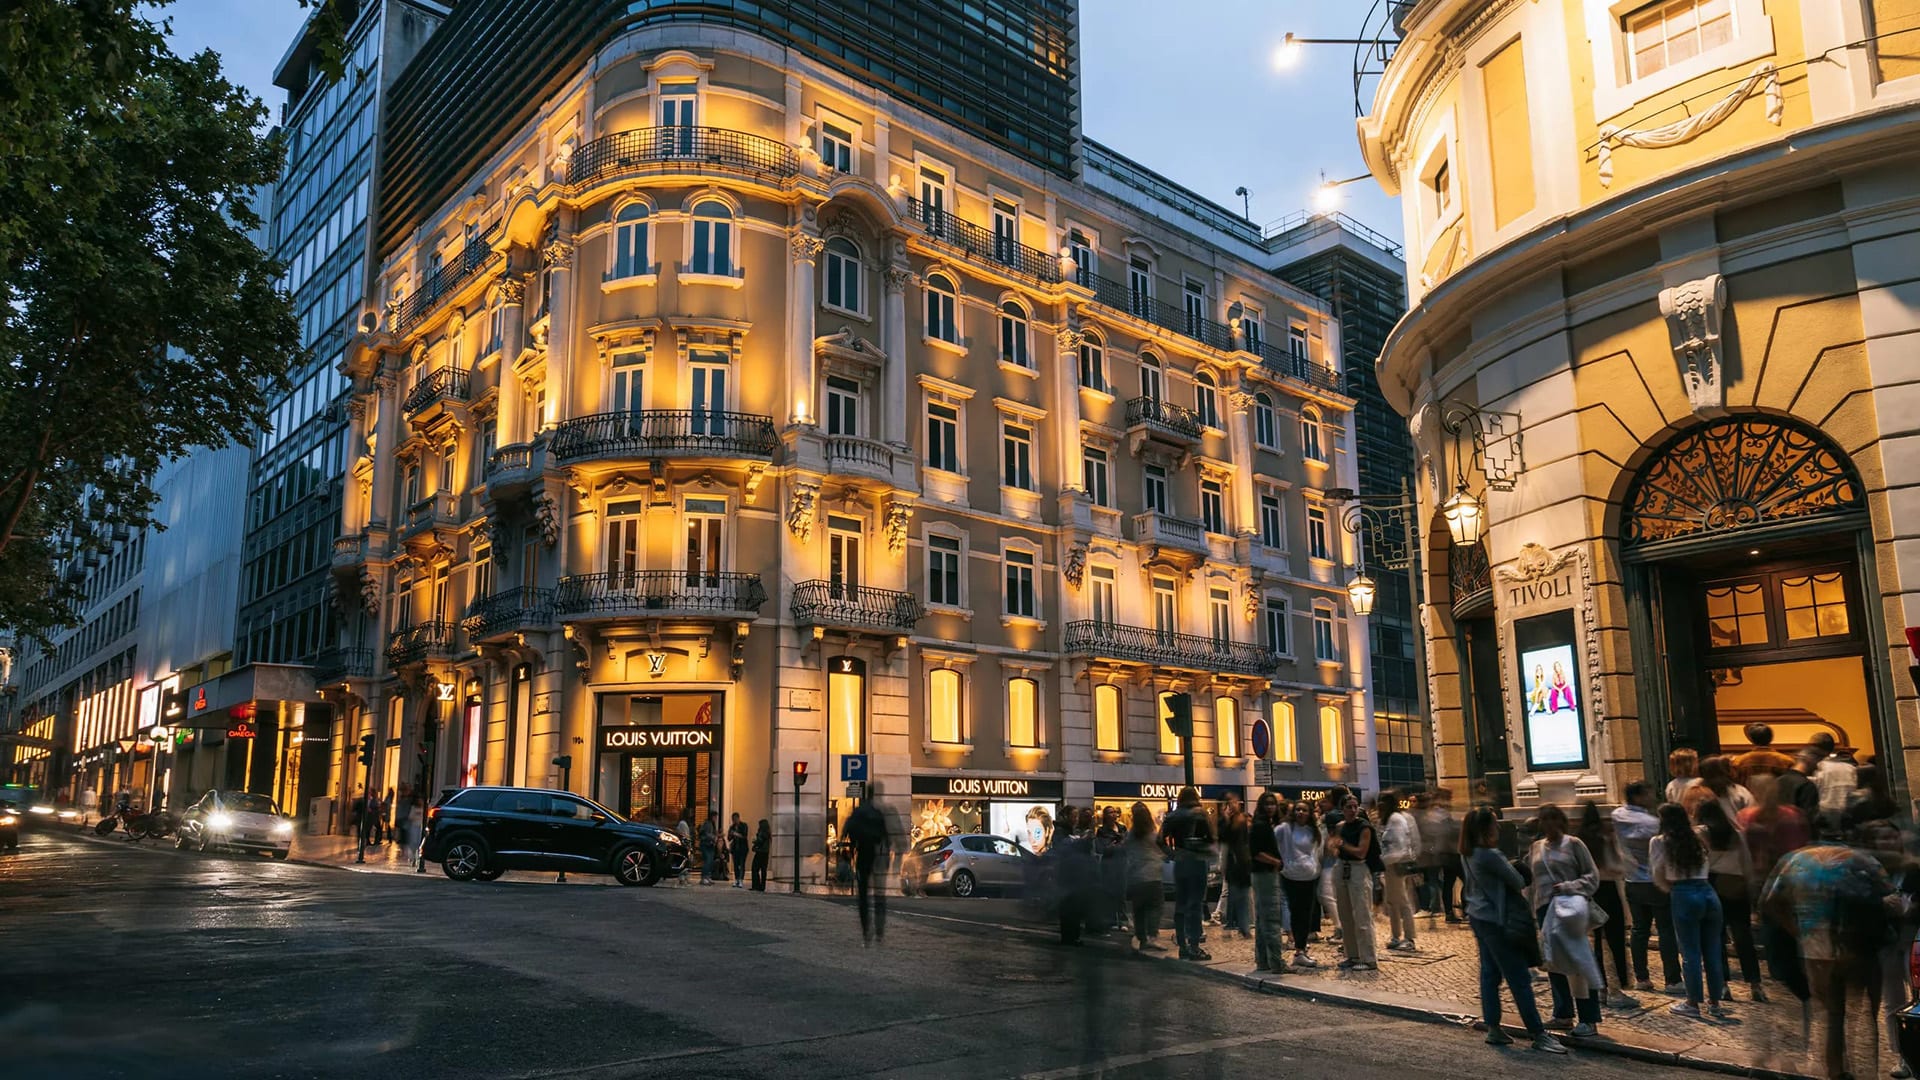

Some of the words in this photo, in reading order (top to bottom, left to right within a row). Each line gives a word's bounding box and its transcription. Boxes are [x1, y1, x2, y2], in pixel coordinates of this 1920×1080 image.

[1510, 575, 1572, 607] TIVOLI
[228, 730, 256, 738] OMEGA
[606, 732, 647, 747] LOUIS
[650, 731, 713, 746] VUITTON
[847, 758, 862, 778] P
[949, 779, 981, 794] LOUIS
[982, 780, 1028, 795] VUITTON
[1141, 784, 1166, 797] LOUIS
